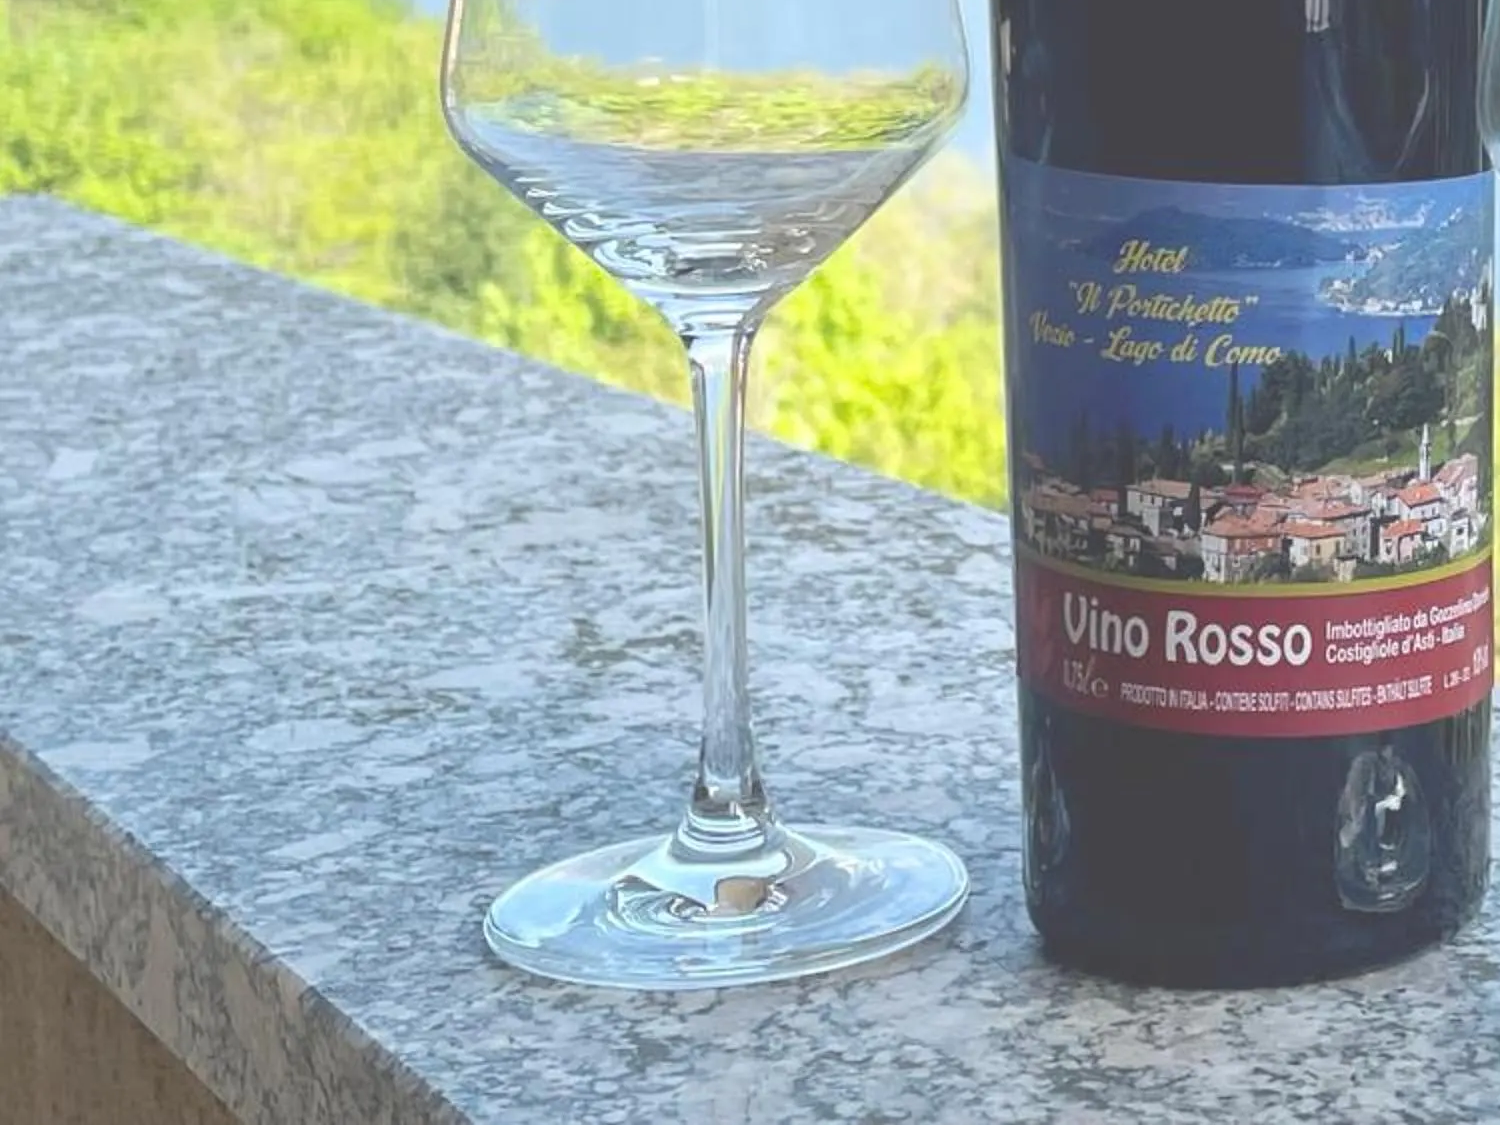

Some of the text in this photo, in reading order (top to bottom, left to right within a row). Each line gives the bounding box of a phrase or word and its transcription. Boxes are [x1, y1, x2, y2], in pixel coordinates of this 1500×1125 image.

[1113, 239, 1190, 274] Hotel
[1100, 326, 1164, 365] Lago
[1171, 333, 1198, 362] di
[1205, 334, 1285, 367] Como
[1063, 592, 1313, 666] Vino Rosso
[1326, 612, 1411, 640] Imbottigliato
[1414, 611, 1428, 629] da
[1326, 638, 1399, 665] Costigliole
[1120, 683, 1167, 708] PRODOTTO
[1169, 689, 1178, 707] IN
[1180, 689, 1209, 710] ITALIA
[1215, 691, 1257, 712] CONTIENE
[1295, 691, 1335, 712] CONTAINS
